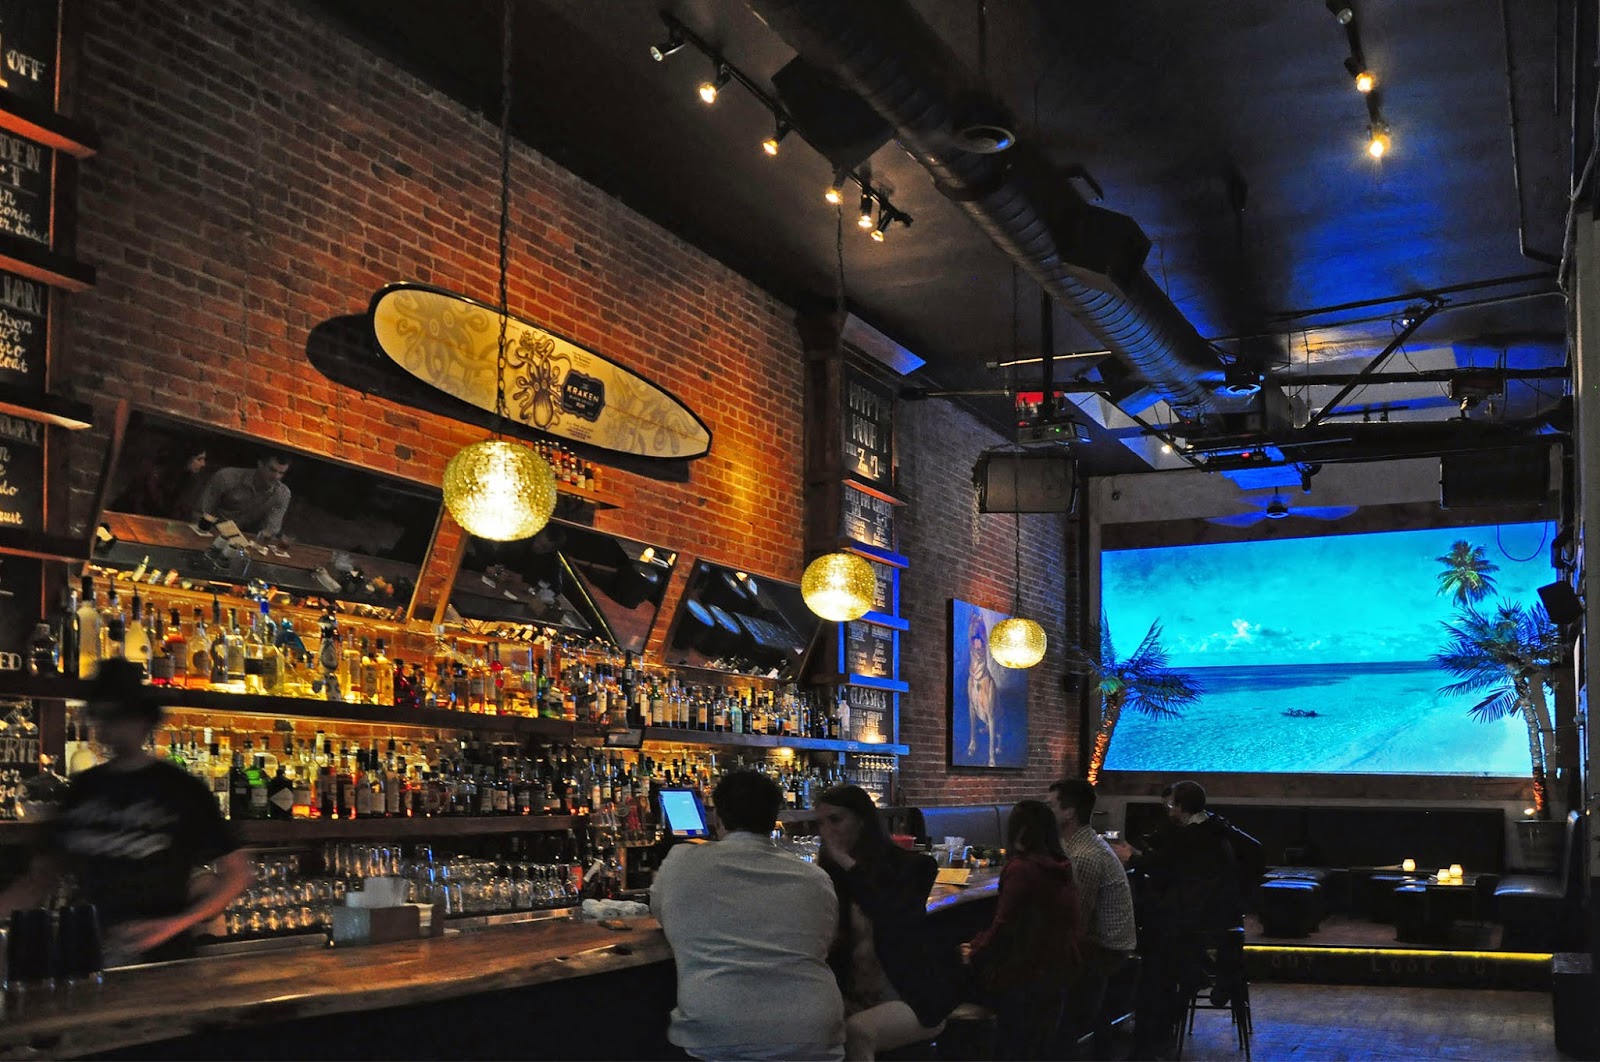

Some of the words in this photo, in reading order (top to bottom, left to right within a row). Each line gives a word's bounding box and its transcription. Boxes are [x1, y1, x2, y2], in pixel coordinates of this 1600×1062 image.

[6, 49, 46, 81] OFF
[566, 384, 600, 402] KRAKEN
[852, 414, 878, 451] HOUR
[849, 687, 888, 710] CLASSICS
